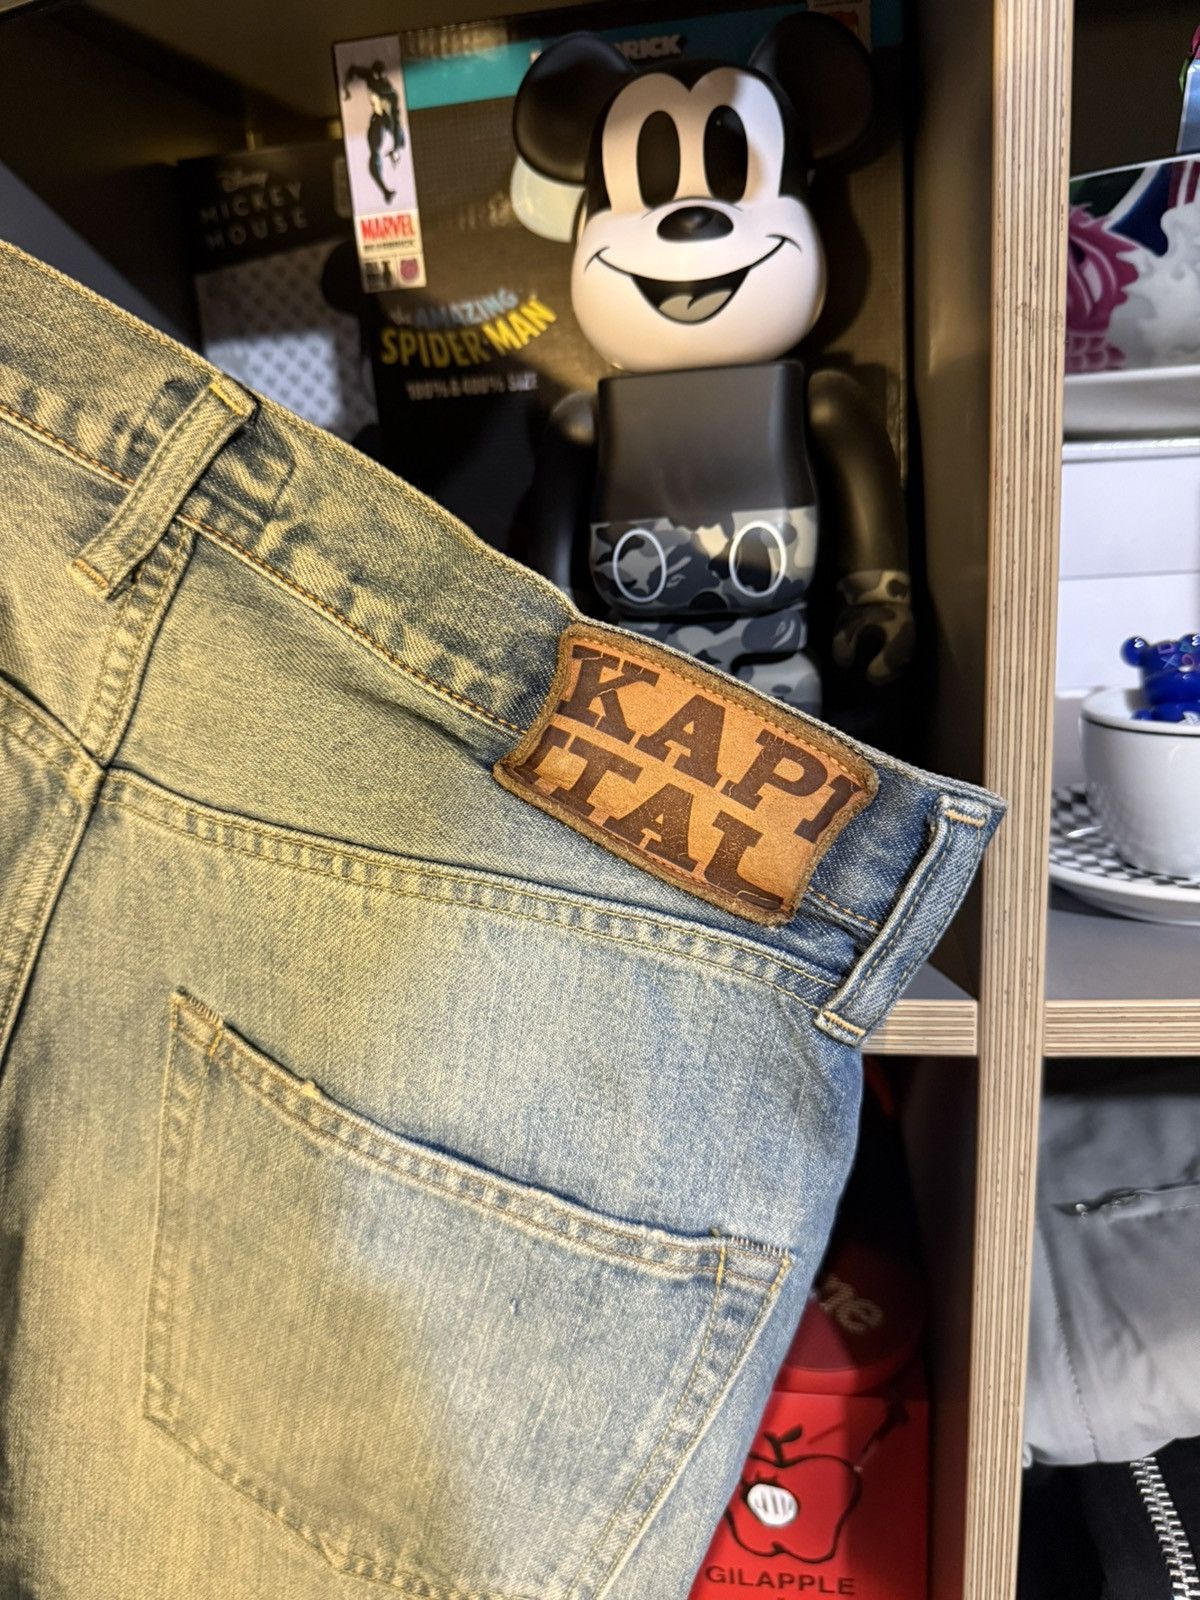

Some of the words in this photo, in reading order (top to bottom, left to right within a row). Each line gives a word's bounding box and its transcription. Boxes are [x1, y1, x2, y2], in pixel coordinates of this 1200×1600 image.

[199, 182, 302, 224] MICKEY
[205, 206, 308, 251] MOUSE
[360, 213, 416, 240] MARVEL
[414, 288, 519, 328] AMAZING
[705, 1565, 855, 1595] GILAPPLE
